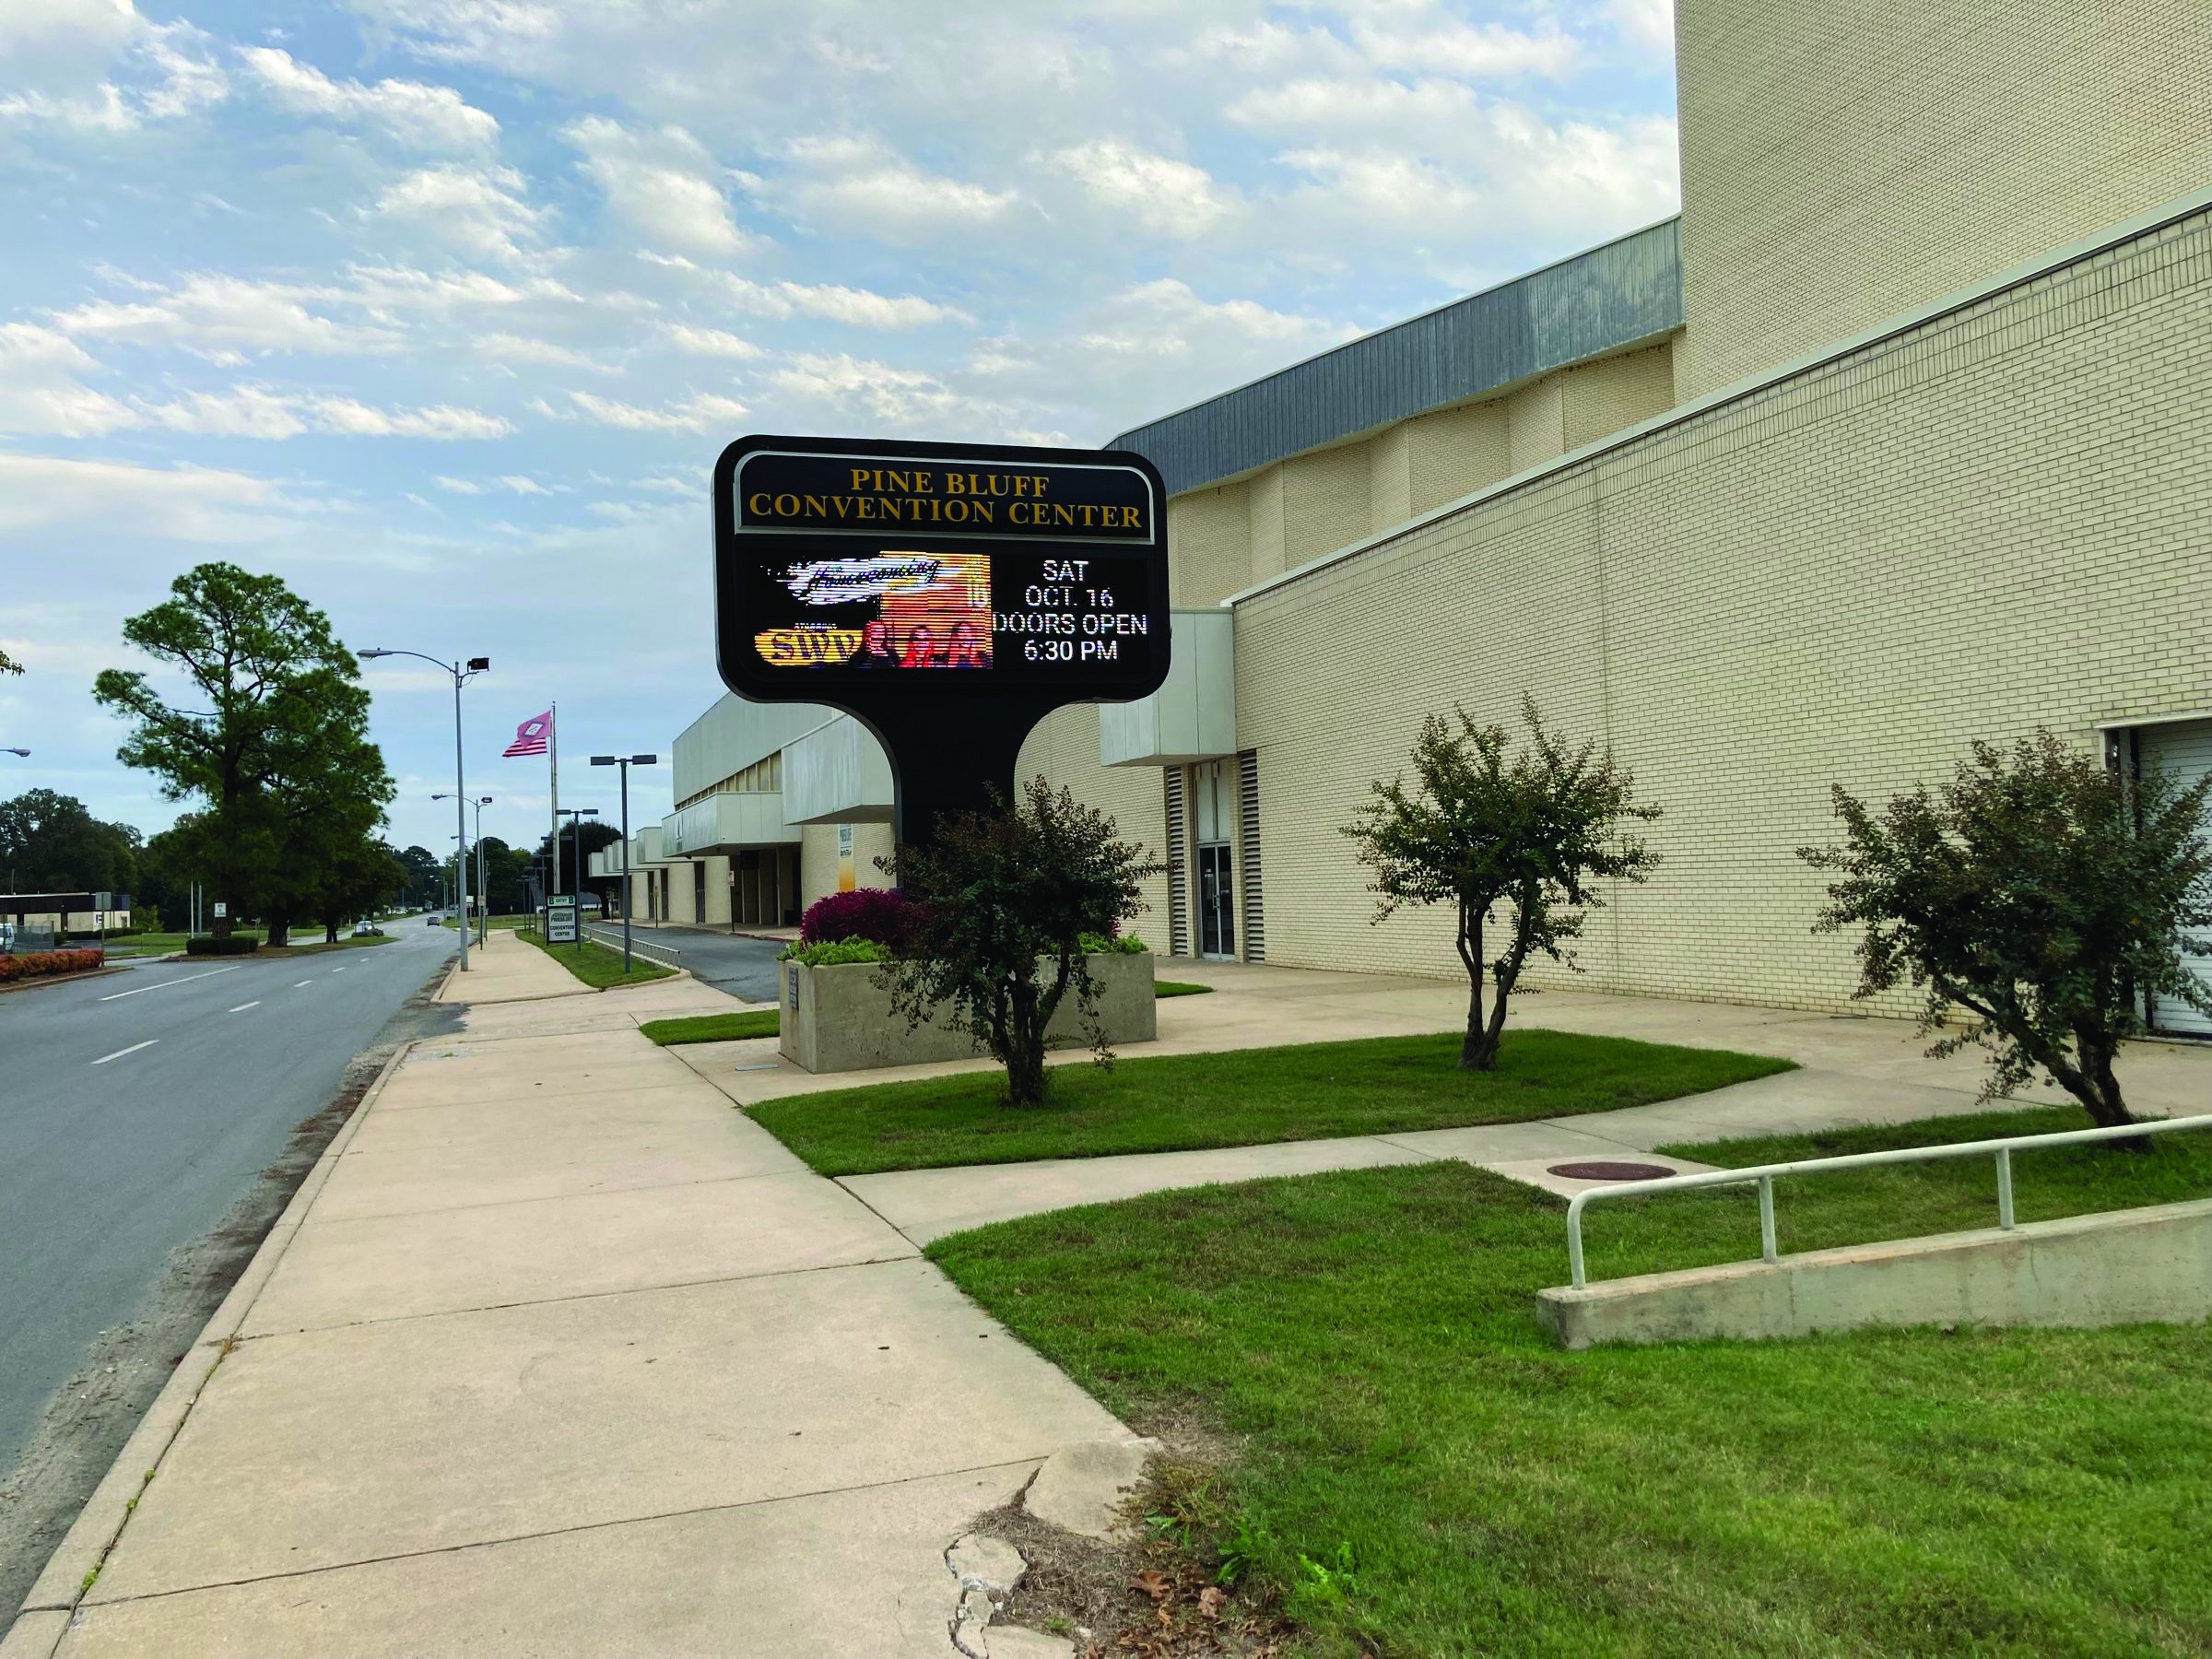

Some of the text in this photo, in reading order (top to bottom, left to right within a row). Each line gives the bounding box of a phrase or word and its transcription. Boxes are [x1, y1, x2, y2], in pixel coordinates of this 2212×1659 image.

[850, 468, 1050, 498] PINE BLUFF
[749, 492, 1143, 528] CONVENTION CENTER
[1042, 559, 1089, 582] SAT
[1025, 584, 1114, 608] OCT. 16
[992, 611, 1148, 635] DOORS OPEN
[1024, 639, 1118, 661] 6:30 PM
